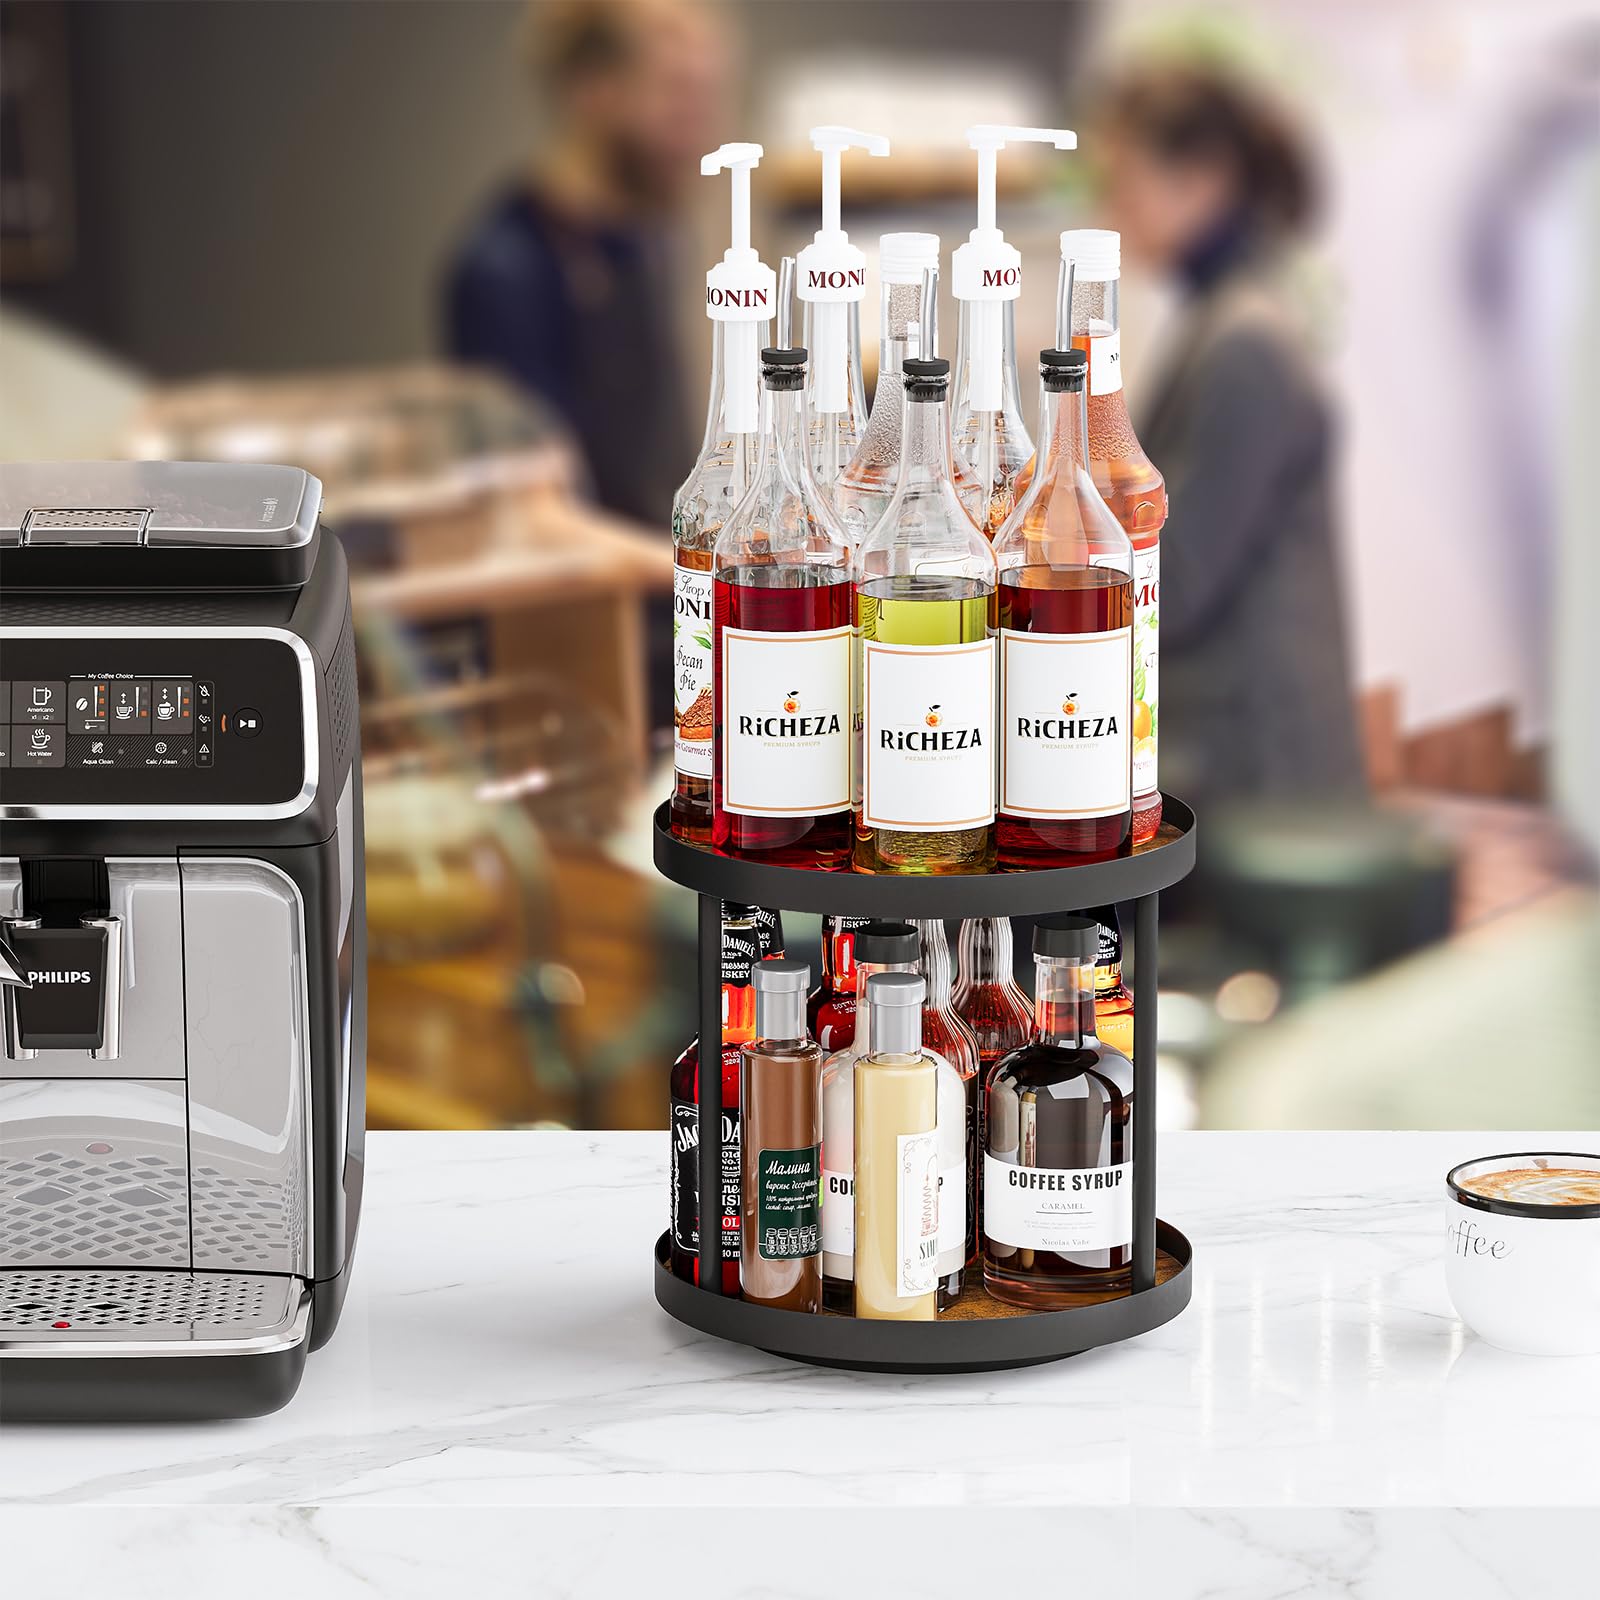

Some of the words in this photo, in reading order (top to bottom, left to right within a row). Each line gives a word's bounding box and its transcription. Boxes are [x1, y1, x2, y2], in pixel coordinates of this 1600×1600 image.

[808, 268, 866, 288] MONI
[675, 594, 712, 620] ONI
[676, 645, 703, 670] Pecan
[679, 669, 696, 691] Pie
[27, 971, 91, 984] PHILIPS
[721, 970, 751, 979] ISKEY
[765, 1160, 811, 1175] Малина
[1009, 1170, 1065, 1191] COFFEE
[1072, 1170, 1123, 1191] SYRUP
[1041, 1202, 1086, 1210] CARAMEL
